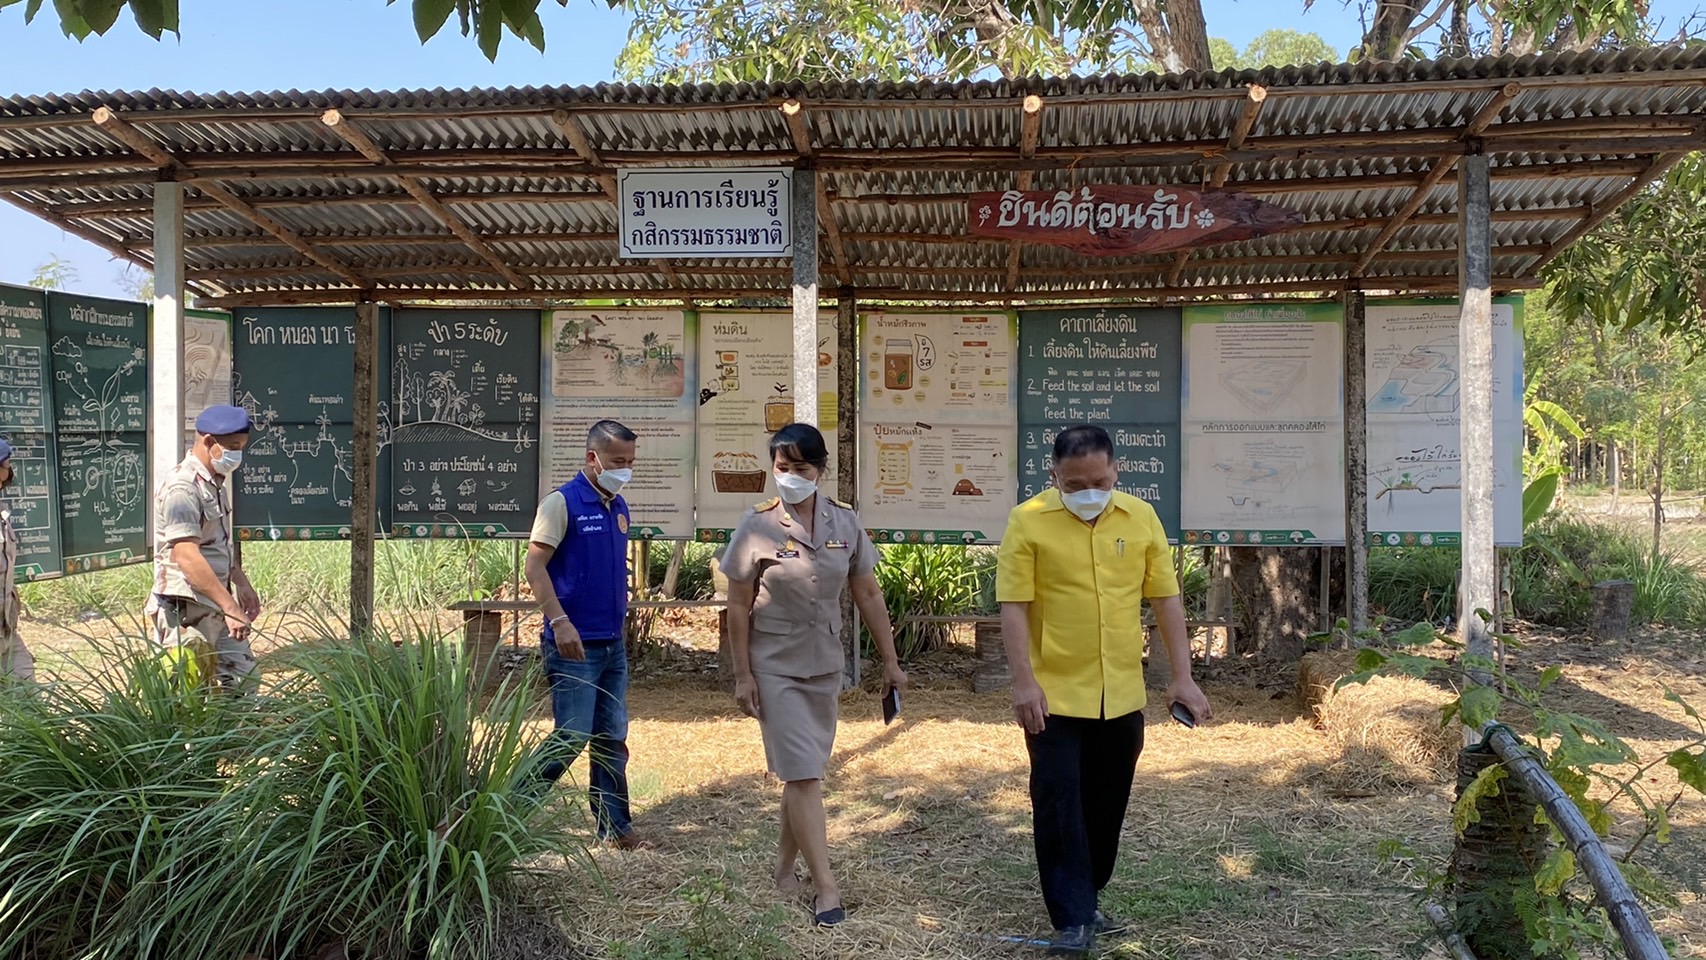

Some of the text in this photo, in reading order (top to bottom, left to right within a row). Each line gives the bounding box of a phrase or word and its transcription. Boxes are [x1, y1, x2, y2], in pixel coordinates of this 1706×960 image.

[633, 179, 779, 217] ฐานการเรียนรู้
[996, 186, 1194, 236] ยินดีต้อนรับ
[632, 219, 783, 246] กสิกรรมธรรมชาติ
[713, 320, 748, 336] ห่มดิน
[877, 316, 927, 329] น้ำหมักชีวภาพ
[1060, 309, 1138, 333] คาถาเลี้ยงดิน
[243, 317, 275, 344] โคก
[279, 326, 316, 344] หนอง
[321, 326, 339, 344] นา
[427, 318, 508, 346] ป่า 5 ระดับ
[922, 347, 931, 358] 7
[1043, 338, 1084, 359] เลี้ยงดิน
[1083, 337, 1158, 359] ให้ดินเลี้ยงพืช
[919, 358, 932, 367] รส
[1043, 379, 1065, 391] Feed
[1067, 380, 1081, 391] the
[1081, 380, 1094, 391] soil
[1096, 381, 1111, 392] and
[1114, 381, 1126, 392] let
[1127, 381, 1142, 392] the
[1144, 381, 1160, 392] soil
[1044, 407, 1111, 423] feed the plant
[873, 424, 922, 439] ปุ๋ยหมักแห้ง
[403, 455, 517, 473] ป่า 3 อย่าง ประโยชน์ 4 อย่าง
